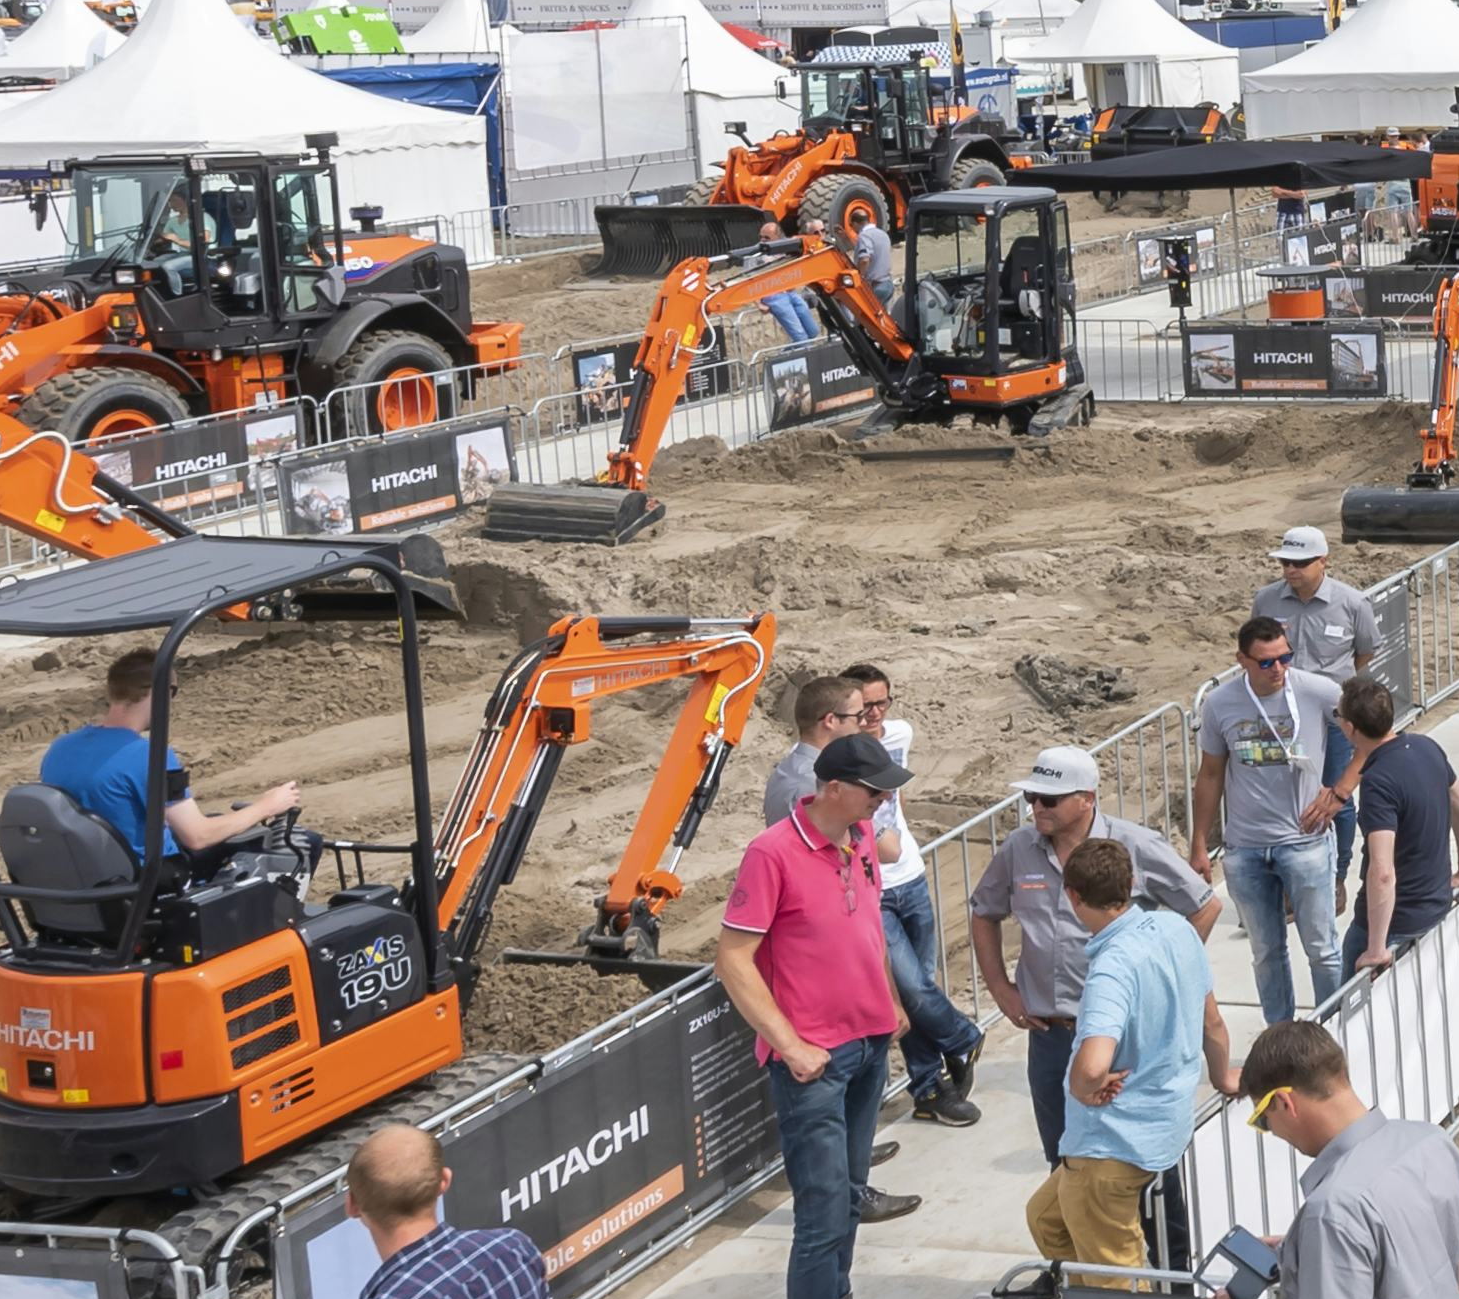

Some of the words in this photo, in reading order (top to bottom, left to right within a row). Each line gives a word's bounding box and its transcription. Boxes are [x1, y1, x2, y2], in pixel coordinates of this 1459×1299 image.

[539, 3, 568, 12] FRITES
[578, 3, 610, 12] SNACKS
[770, 160, 803, 205] HITACHI
[1314, 242, 1337, 256] HITACHI
[1382, 293, 1434, 303] HITACHI
[1254, 352, 1314, 364] HITACHI
[156, 452, 228, 481] HITACHI
[371, 464, 438, 493] HITACHI
[337, 933, 405, 980] ZAXIS
[339, 955, 412, 1010] 19U
[688, 1000, 731, 1034] ZX10U-2
[500, 1104, 649, 1223] HITACHI
[582, 1188, 664, 1252] solutions
